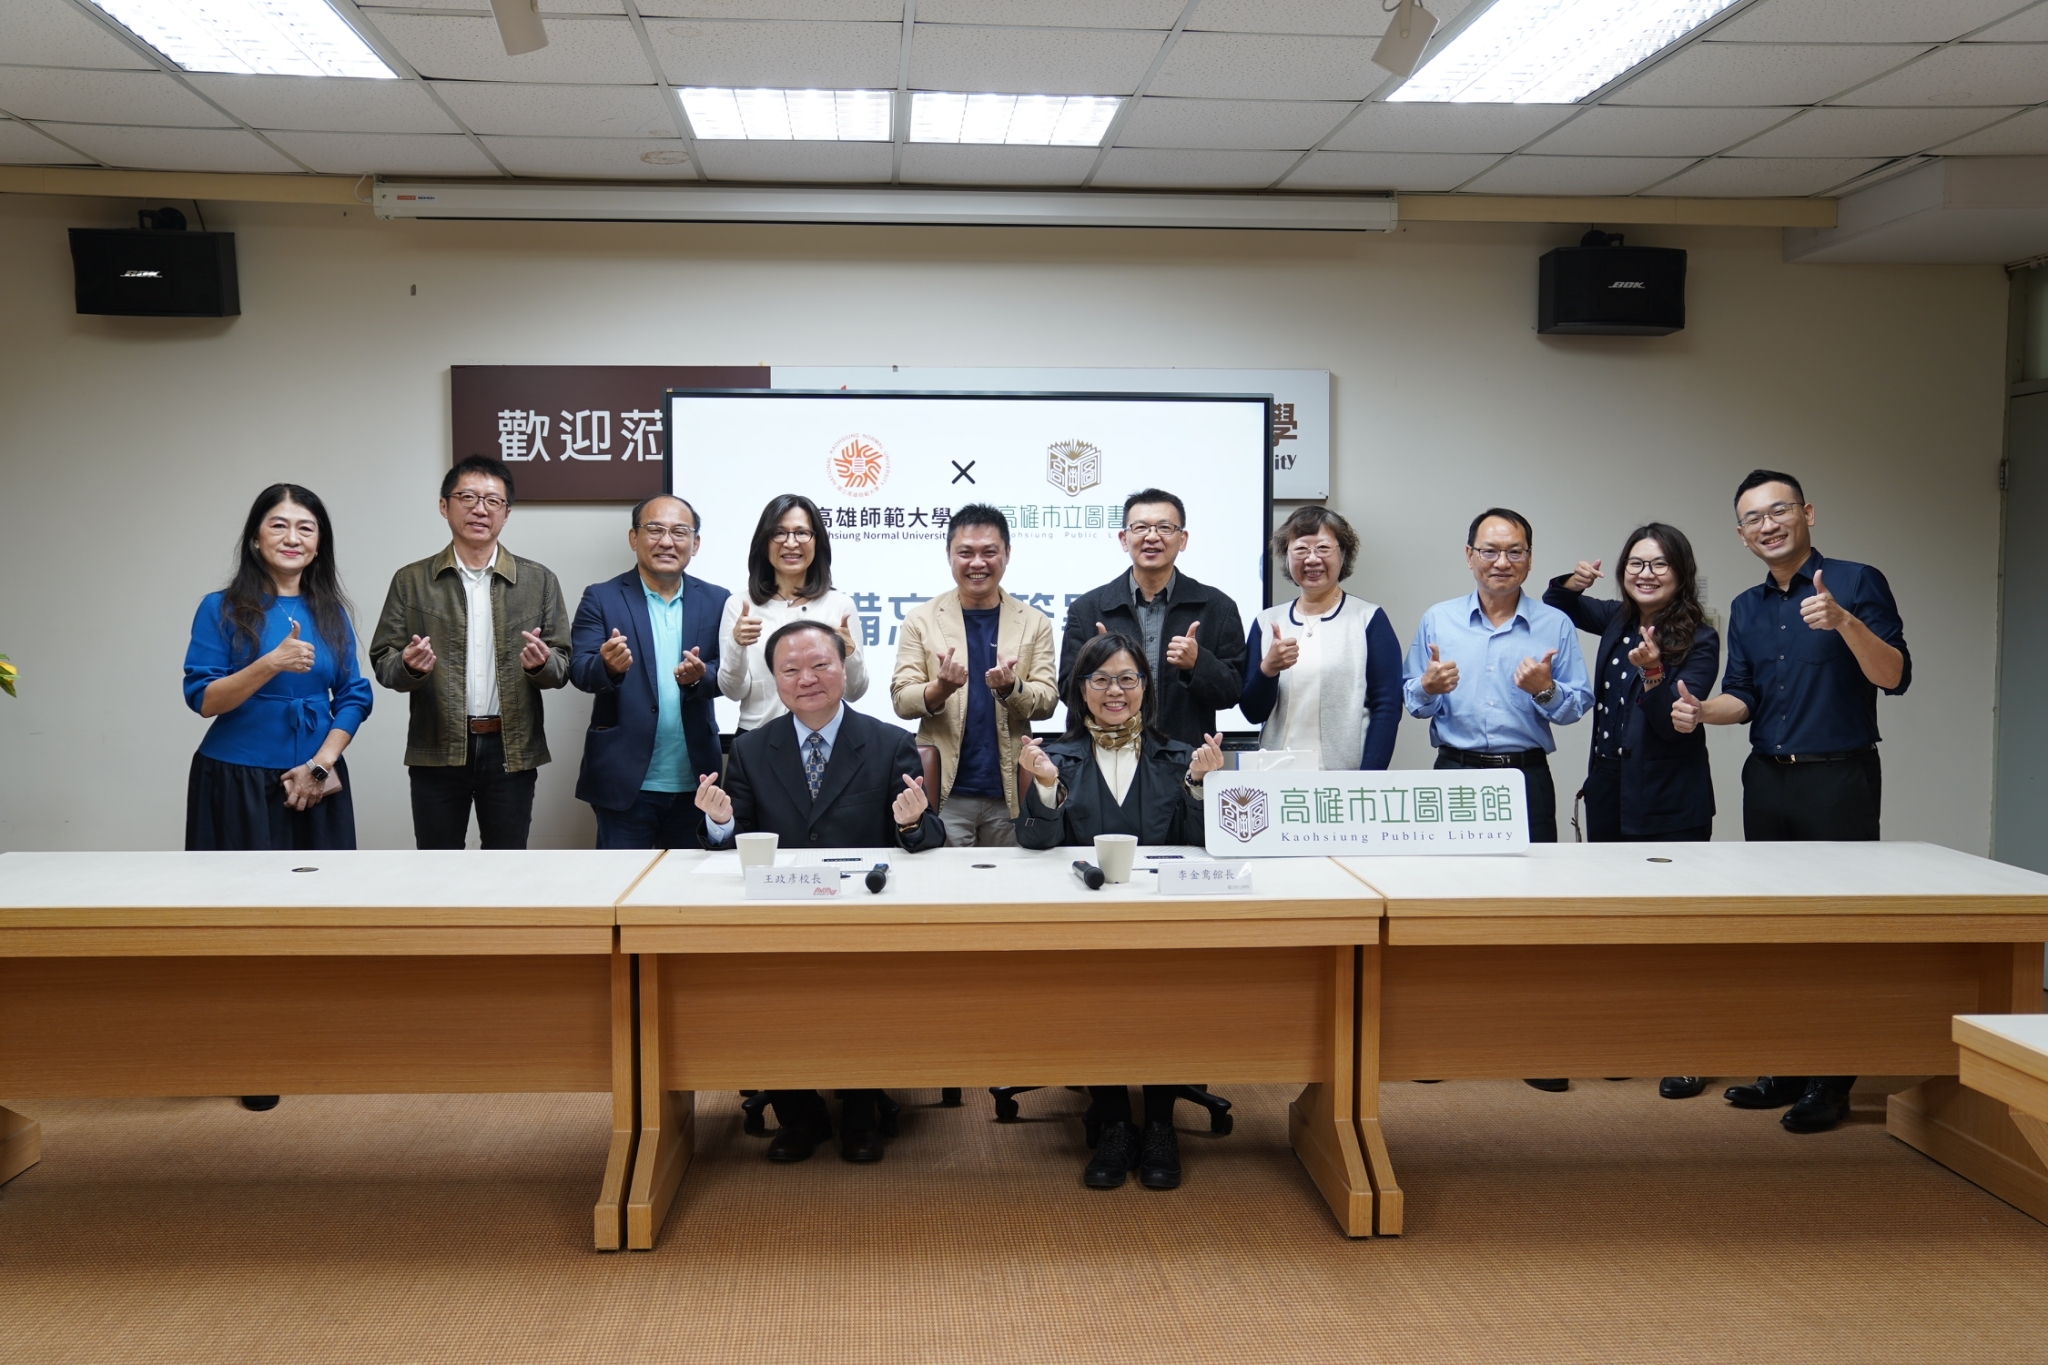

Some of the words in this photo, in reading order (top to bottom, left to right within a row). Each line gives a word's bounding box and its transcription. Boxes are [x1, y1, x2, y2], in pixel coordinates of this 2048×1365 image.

[1608, 281, 1645, 289] BOK
[498, 409, 663, 462] 歡迎蒞
[827, 531, 861, 542] hsiung
[863, 531, 900, 540] Normal
[902, 531, 948, 540] Universit
[1280, 785, 1512, 824] 高雄市立圖書館
[1281, 832, 1369, 843] Kaohsiung
[1381, 831, 1435, 841] Public
[1448, 831, 1513, 840] Library
